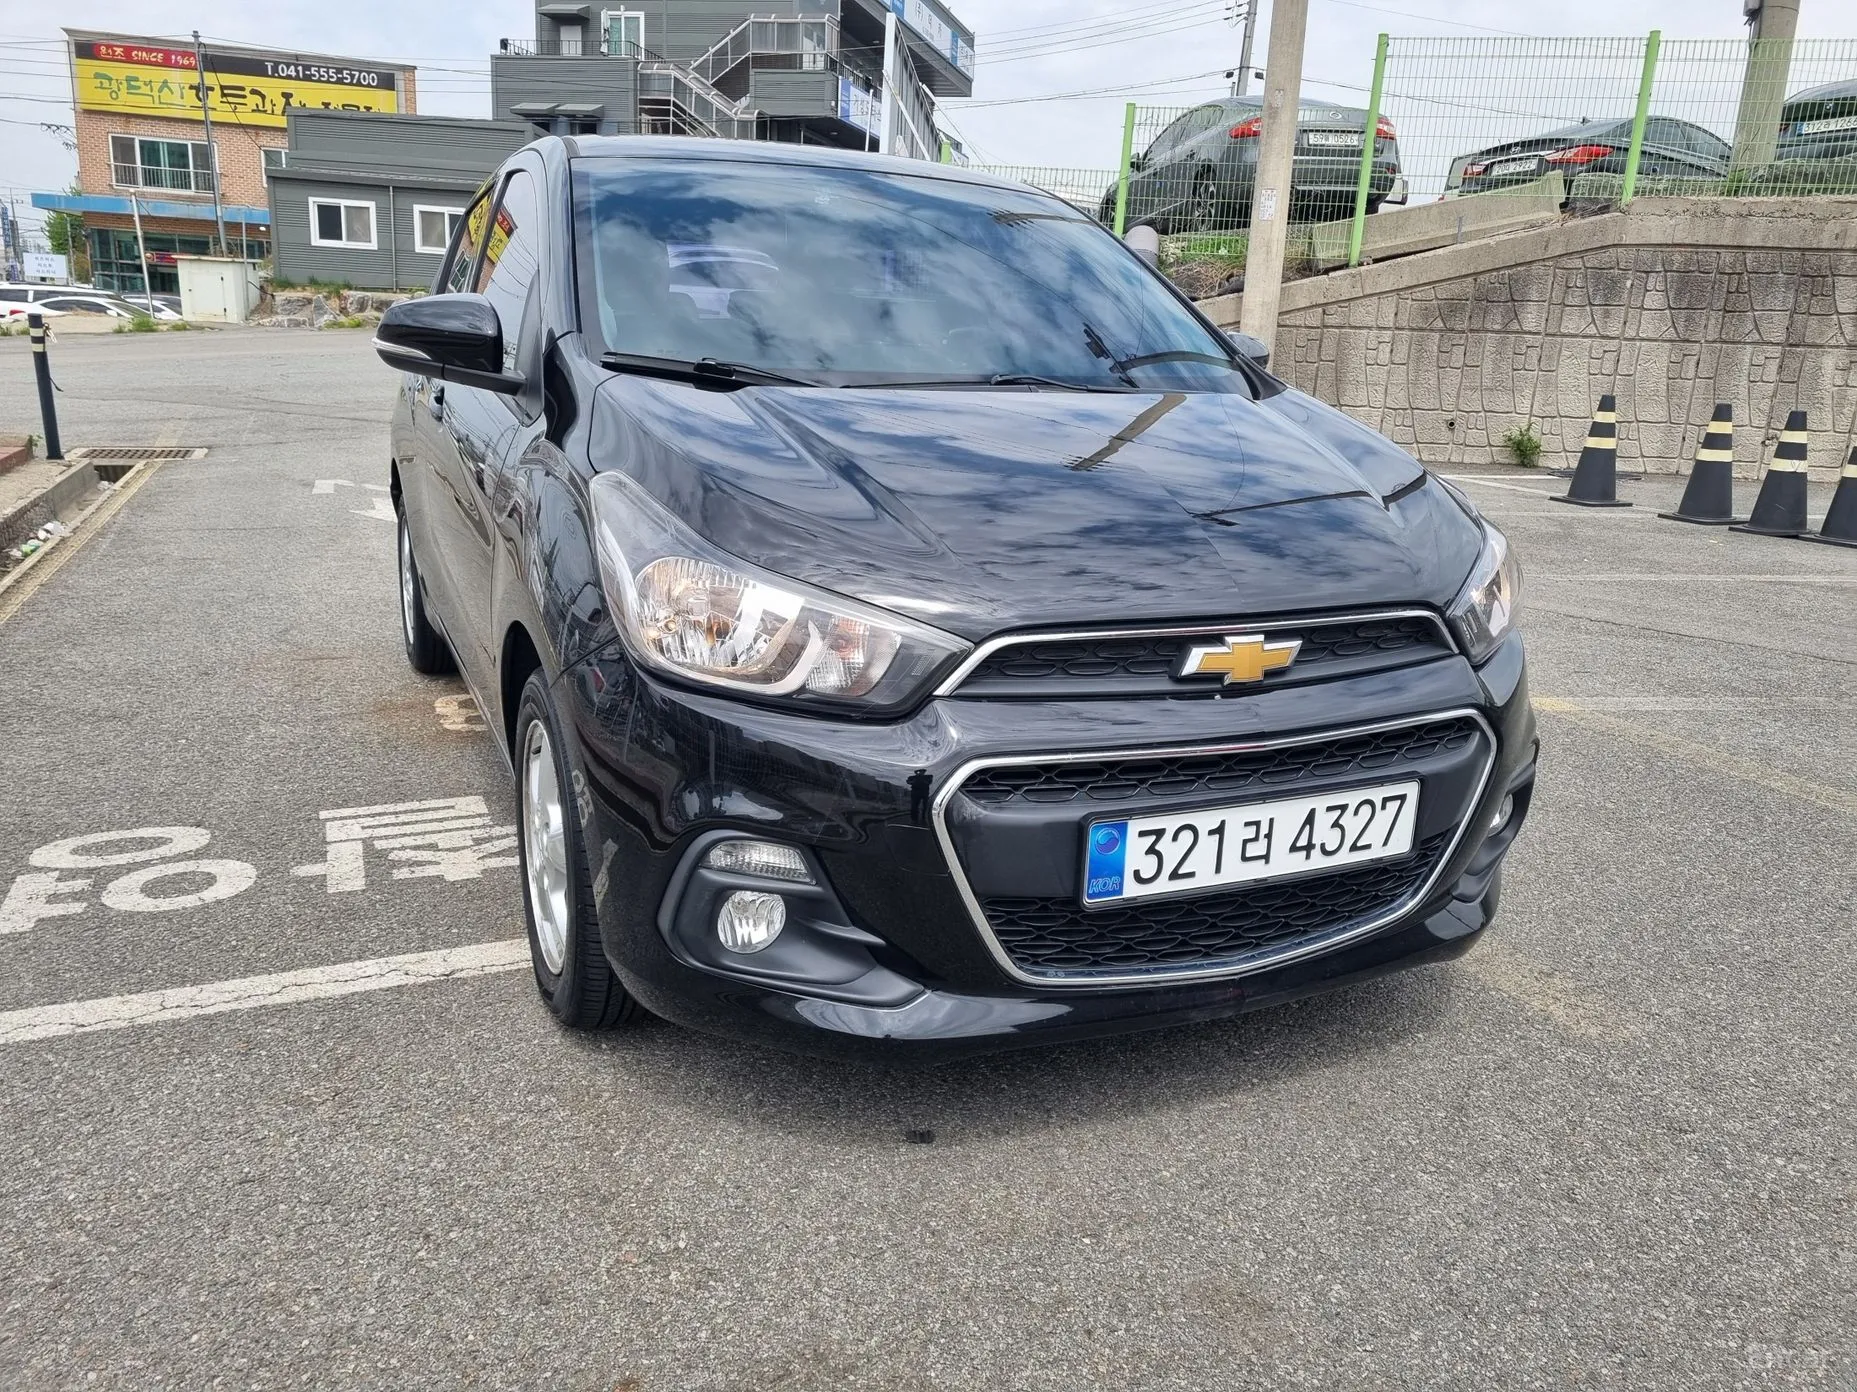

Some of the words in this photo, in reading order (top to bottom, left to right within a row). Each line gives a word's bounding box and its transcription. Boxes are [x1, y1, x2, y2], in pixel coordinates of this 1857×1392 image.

[100, 46, 126, 60] 원조
[131, 50, 164, 63] SINCE
[170, 54, 196, 67] 1969
[264, 61, 378, 86] T.041-555-5700
[1334, 134, 1355, 144] 0526
[1132, 817, 1275, 886] 321러
[1288, 793, 1408, 861] 4327
[1088, 876, 1121, 894] KOR
